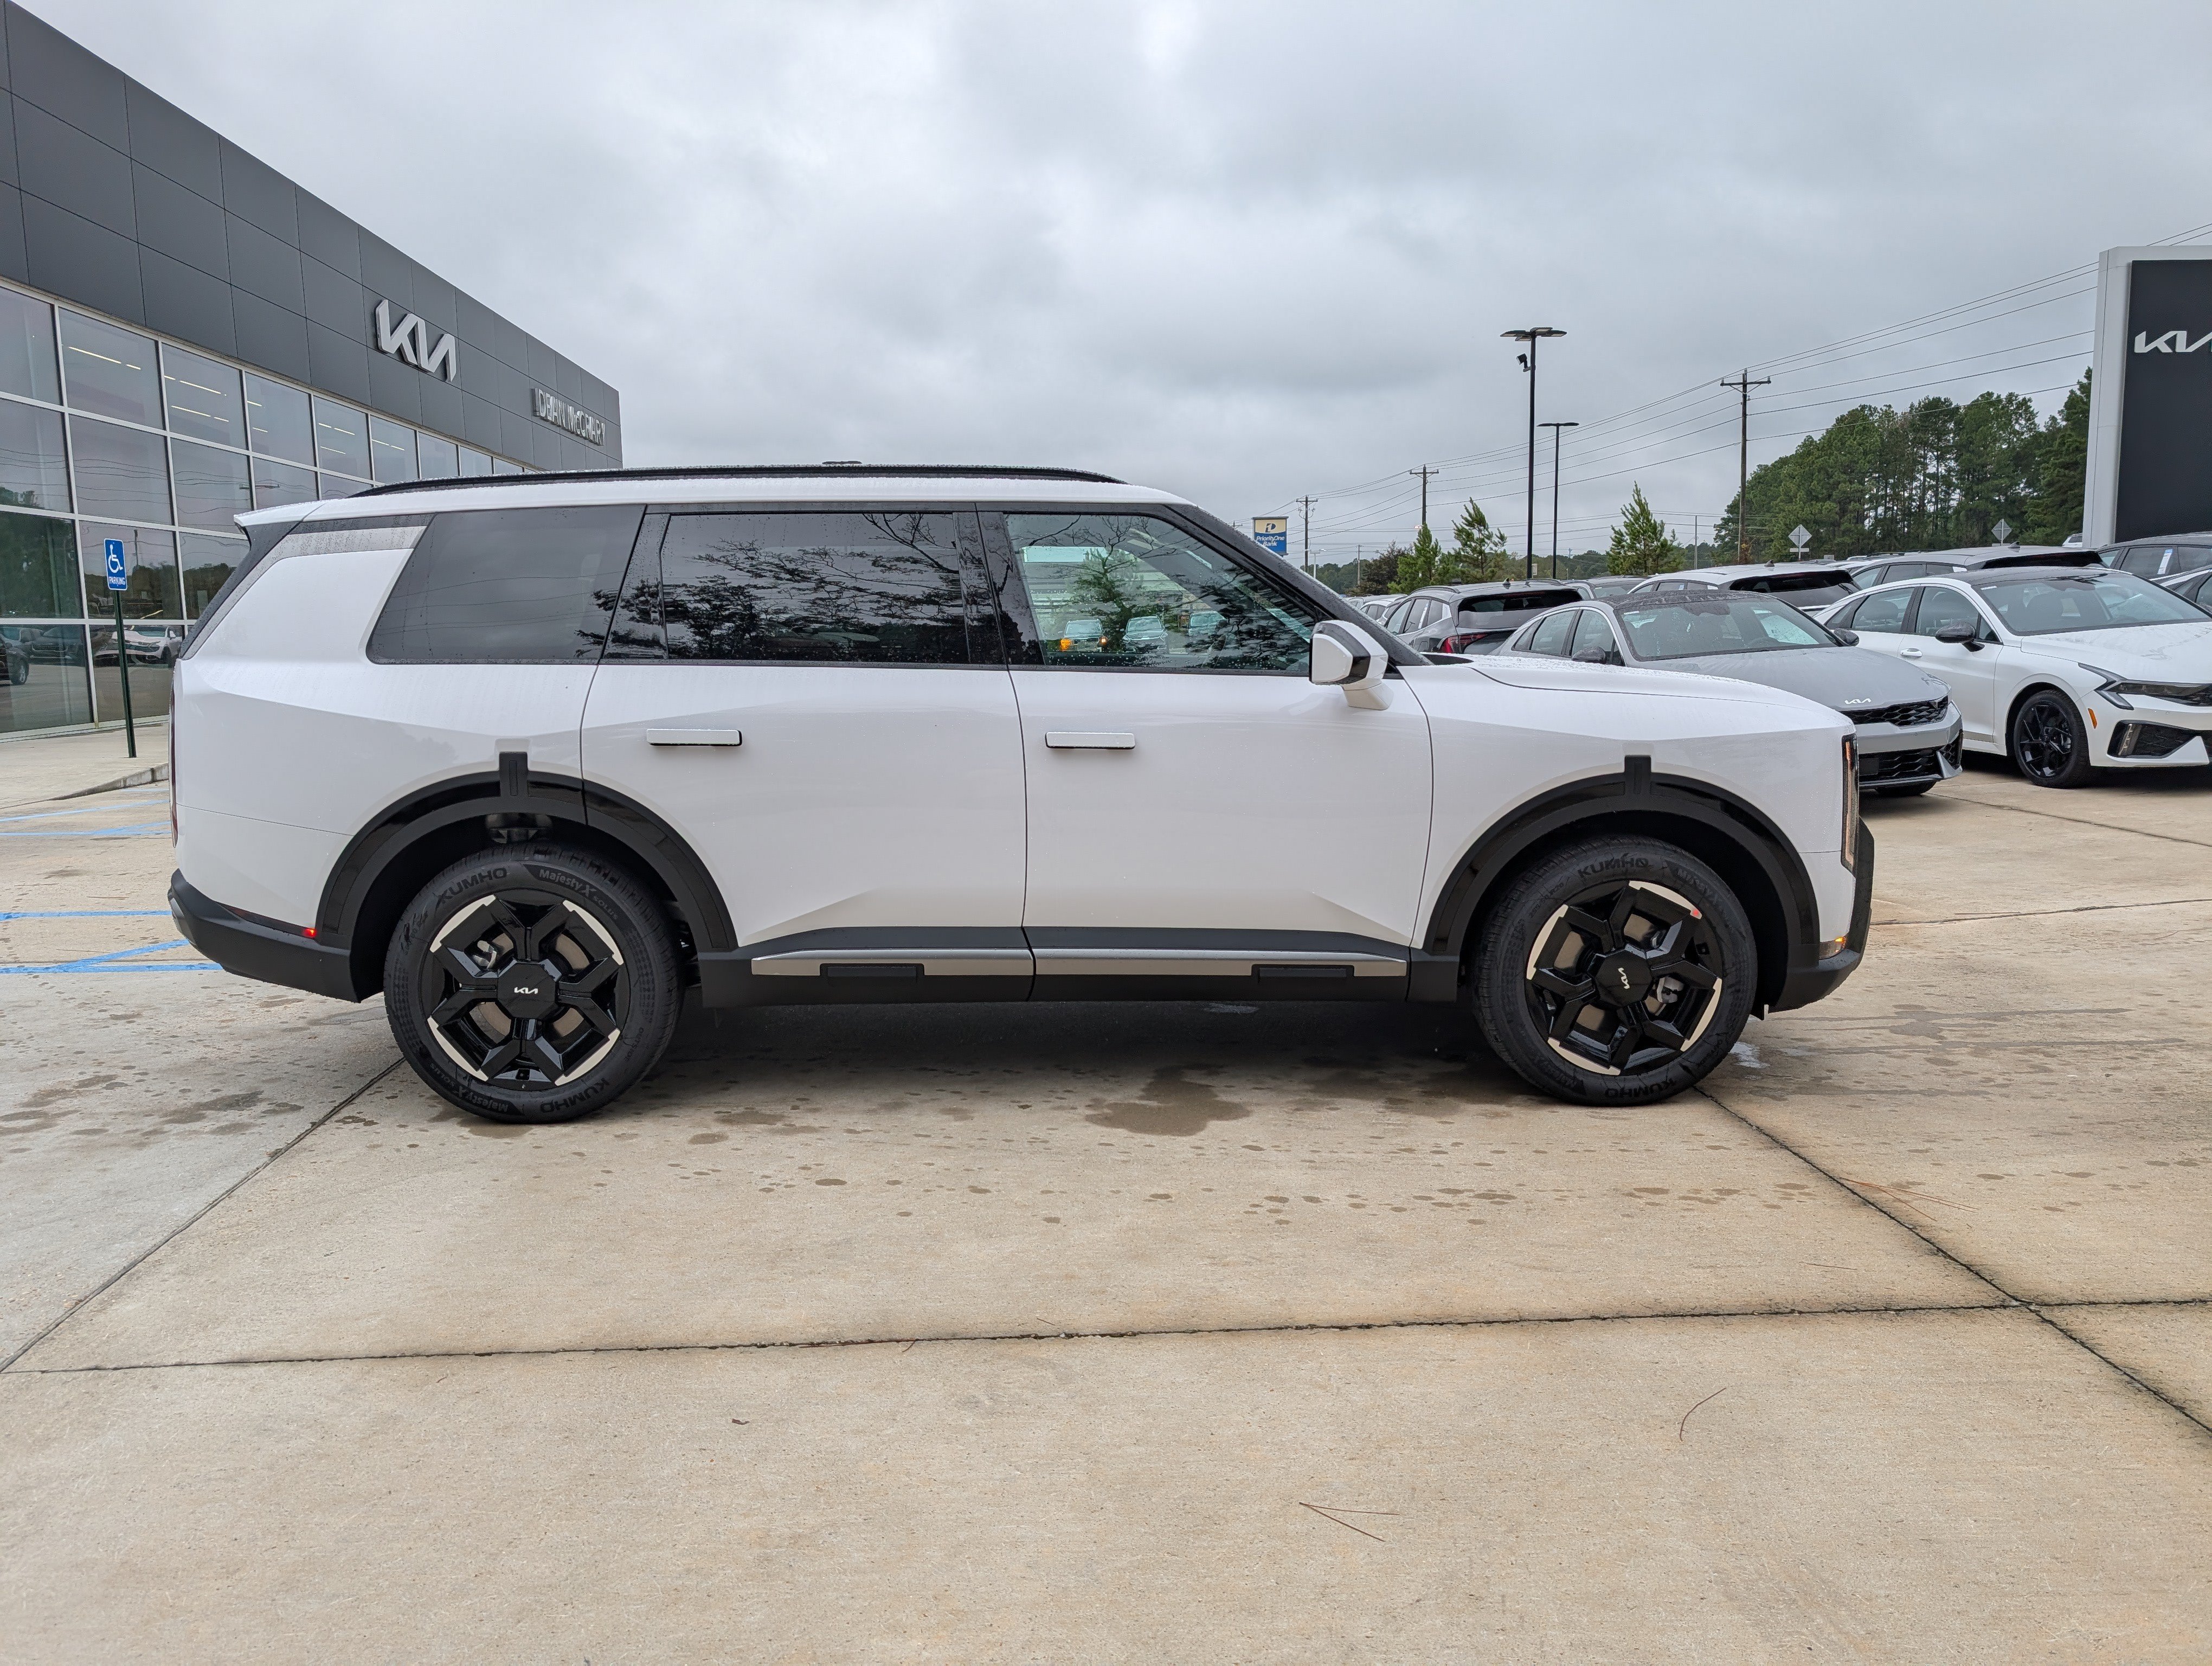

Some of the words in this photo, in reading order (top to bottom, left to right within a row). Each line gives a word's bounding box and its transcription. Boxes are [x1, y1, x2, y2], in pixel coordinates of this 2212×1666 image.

[376, 299, 456, 382] KIA
[533, 388, 565, 428] DEAN
[567, 404, 606, 446] McCRARY
[109, 576, 126, 586] PARKING
[539, 869, 583, 890] Majesty
[1578, 857, 1650, 878] KUMHO
[441, 868, 507, 900] KUMHO
[513, 986, 538, 995] KIA
[540, 1078, 610, 1113] KUMHO
